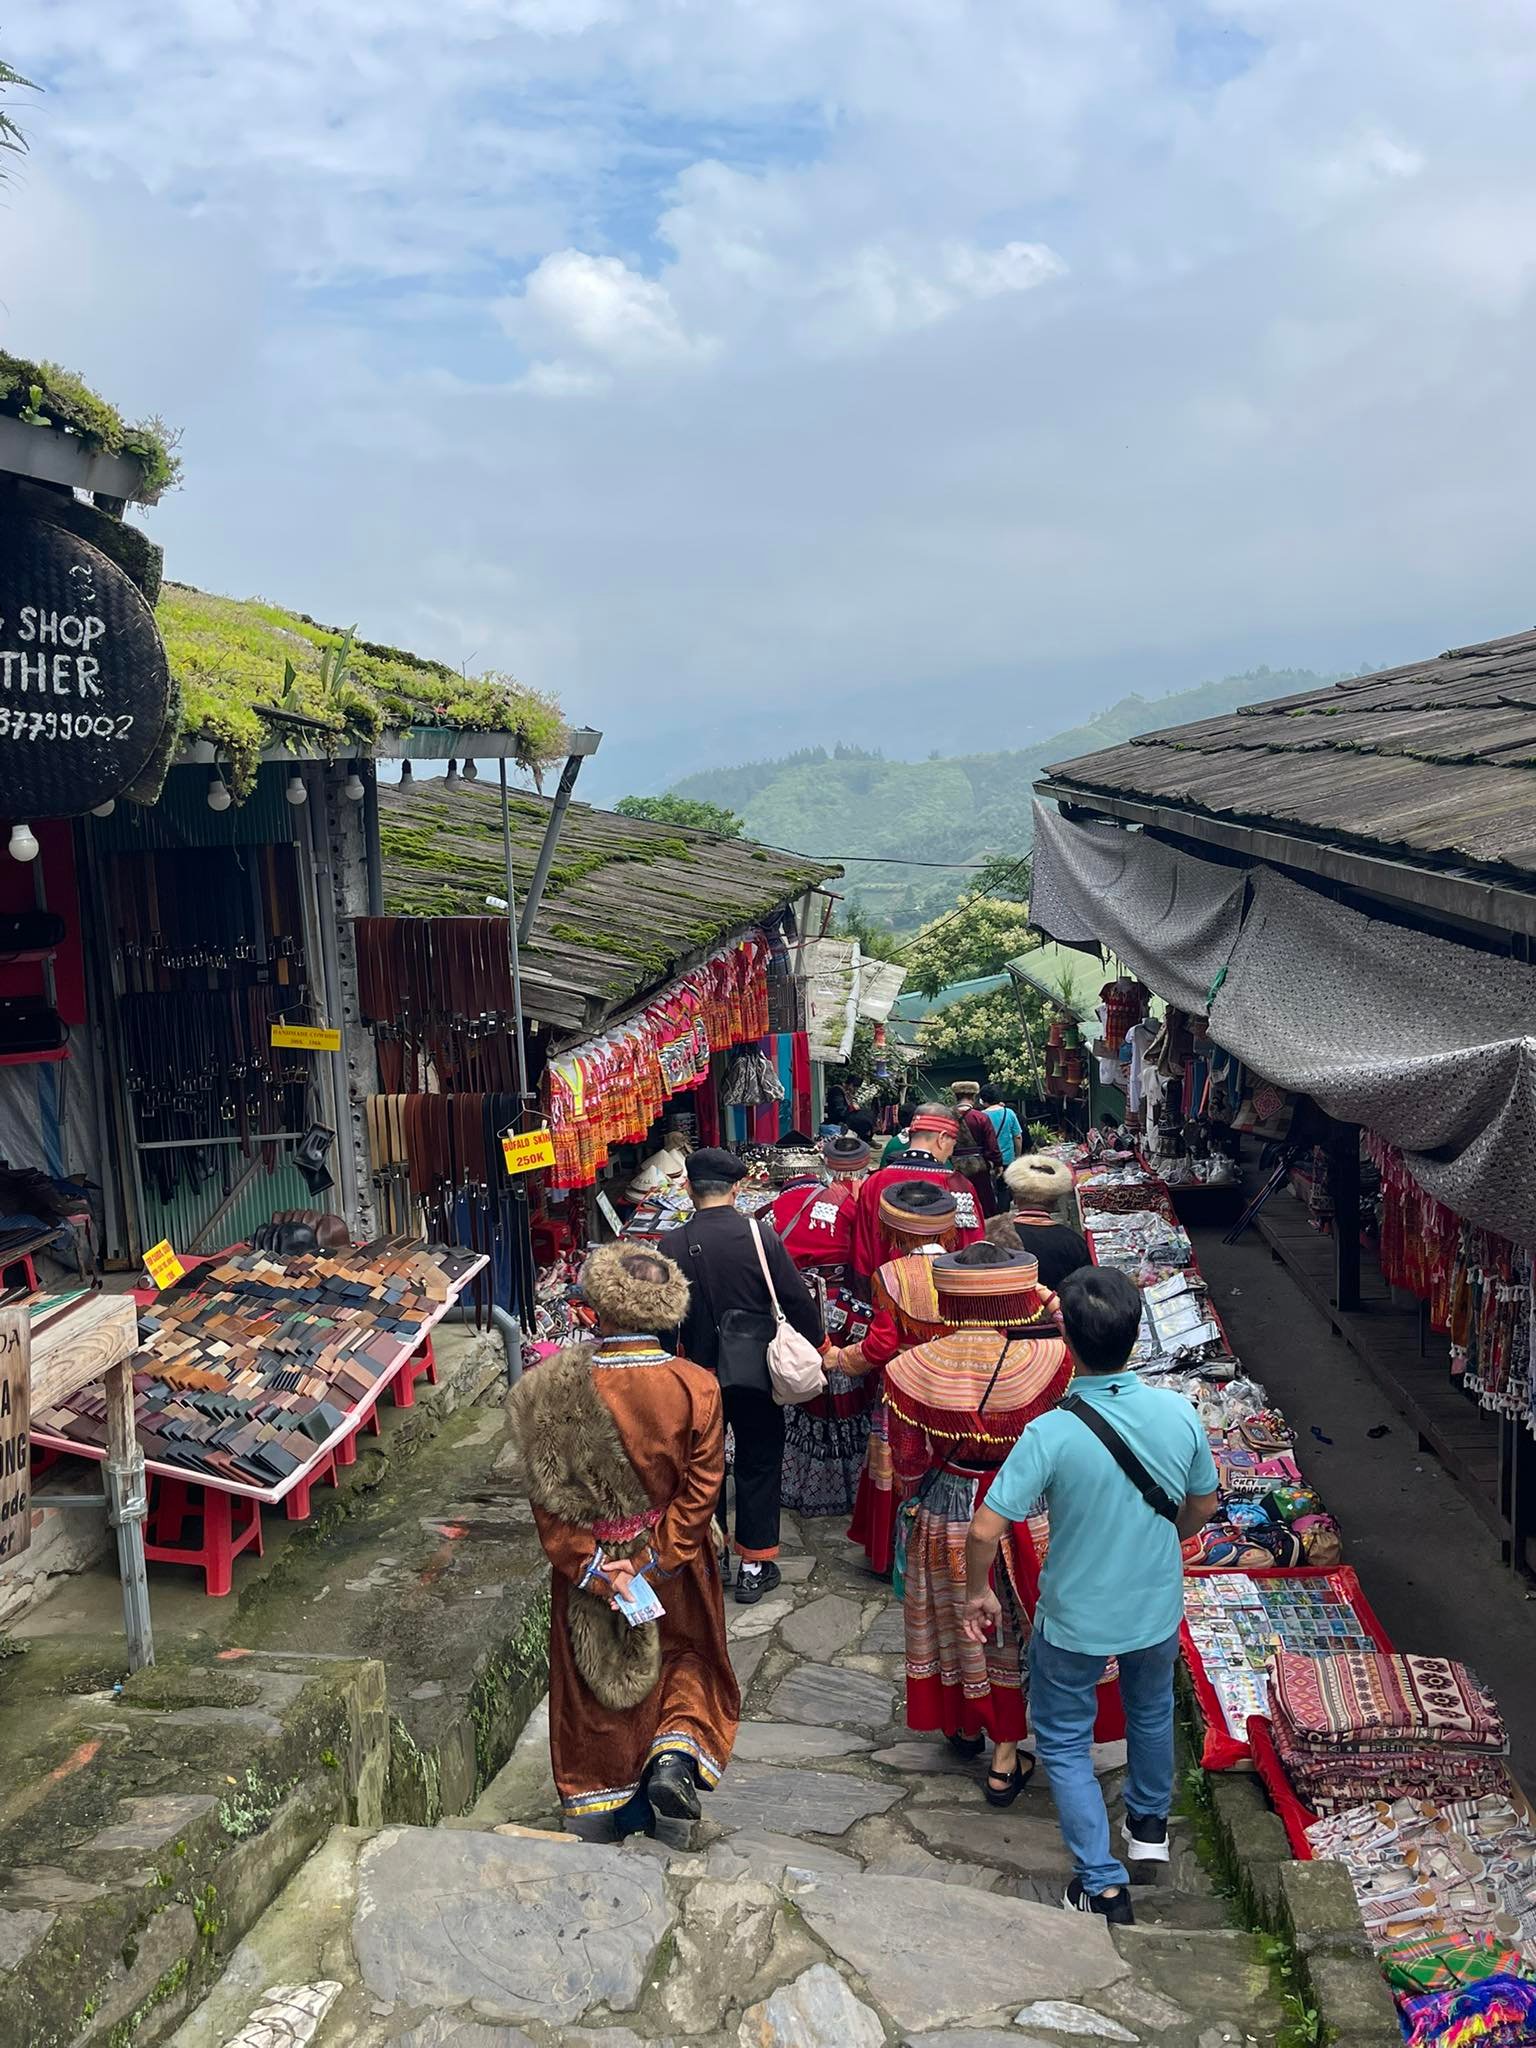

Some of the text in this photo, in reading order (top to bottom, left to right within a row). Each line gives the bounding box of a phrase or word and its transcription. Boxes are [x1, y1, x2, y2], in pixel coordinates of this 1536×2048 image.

[18, 606, 106, 651] SHOP
[0, 651, 100, 698] THER
[503, 1137, 530, 1152] BUFALO
[516, 1152, 544, 1167] 250K
